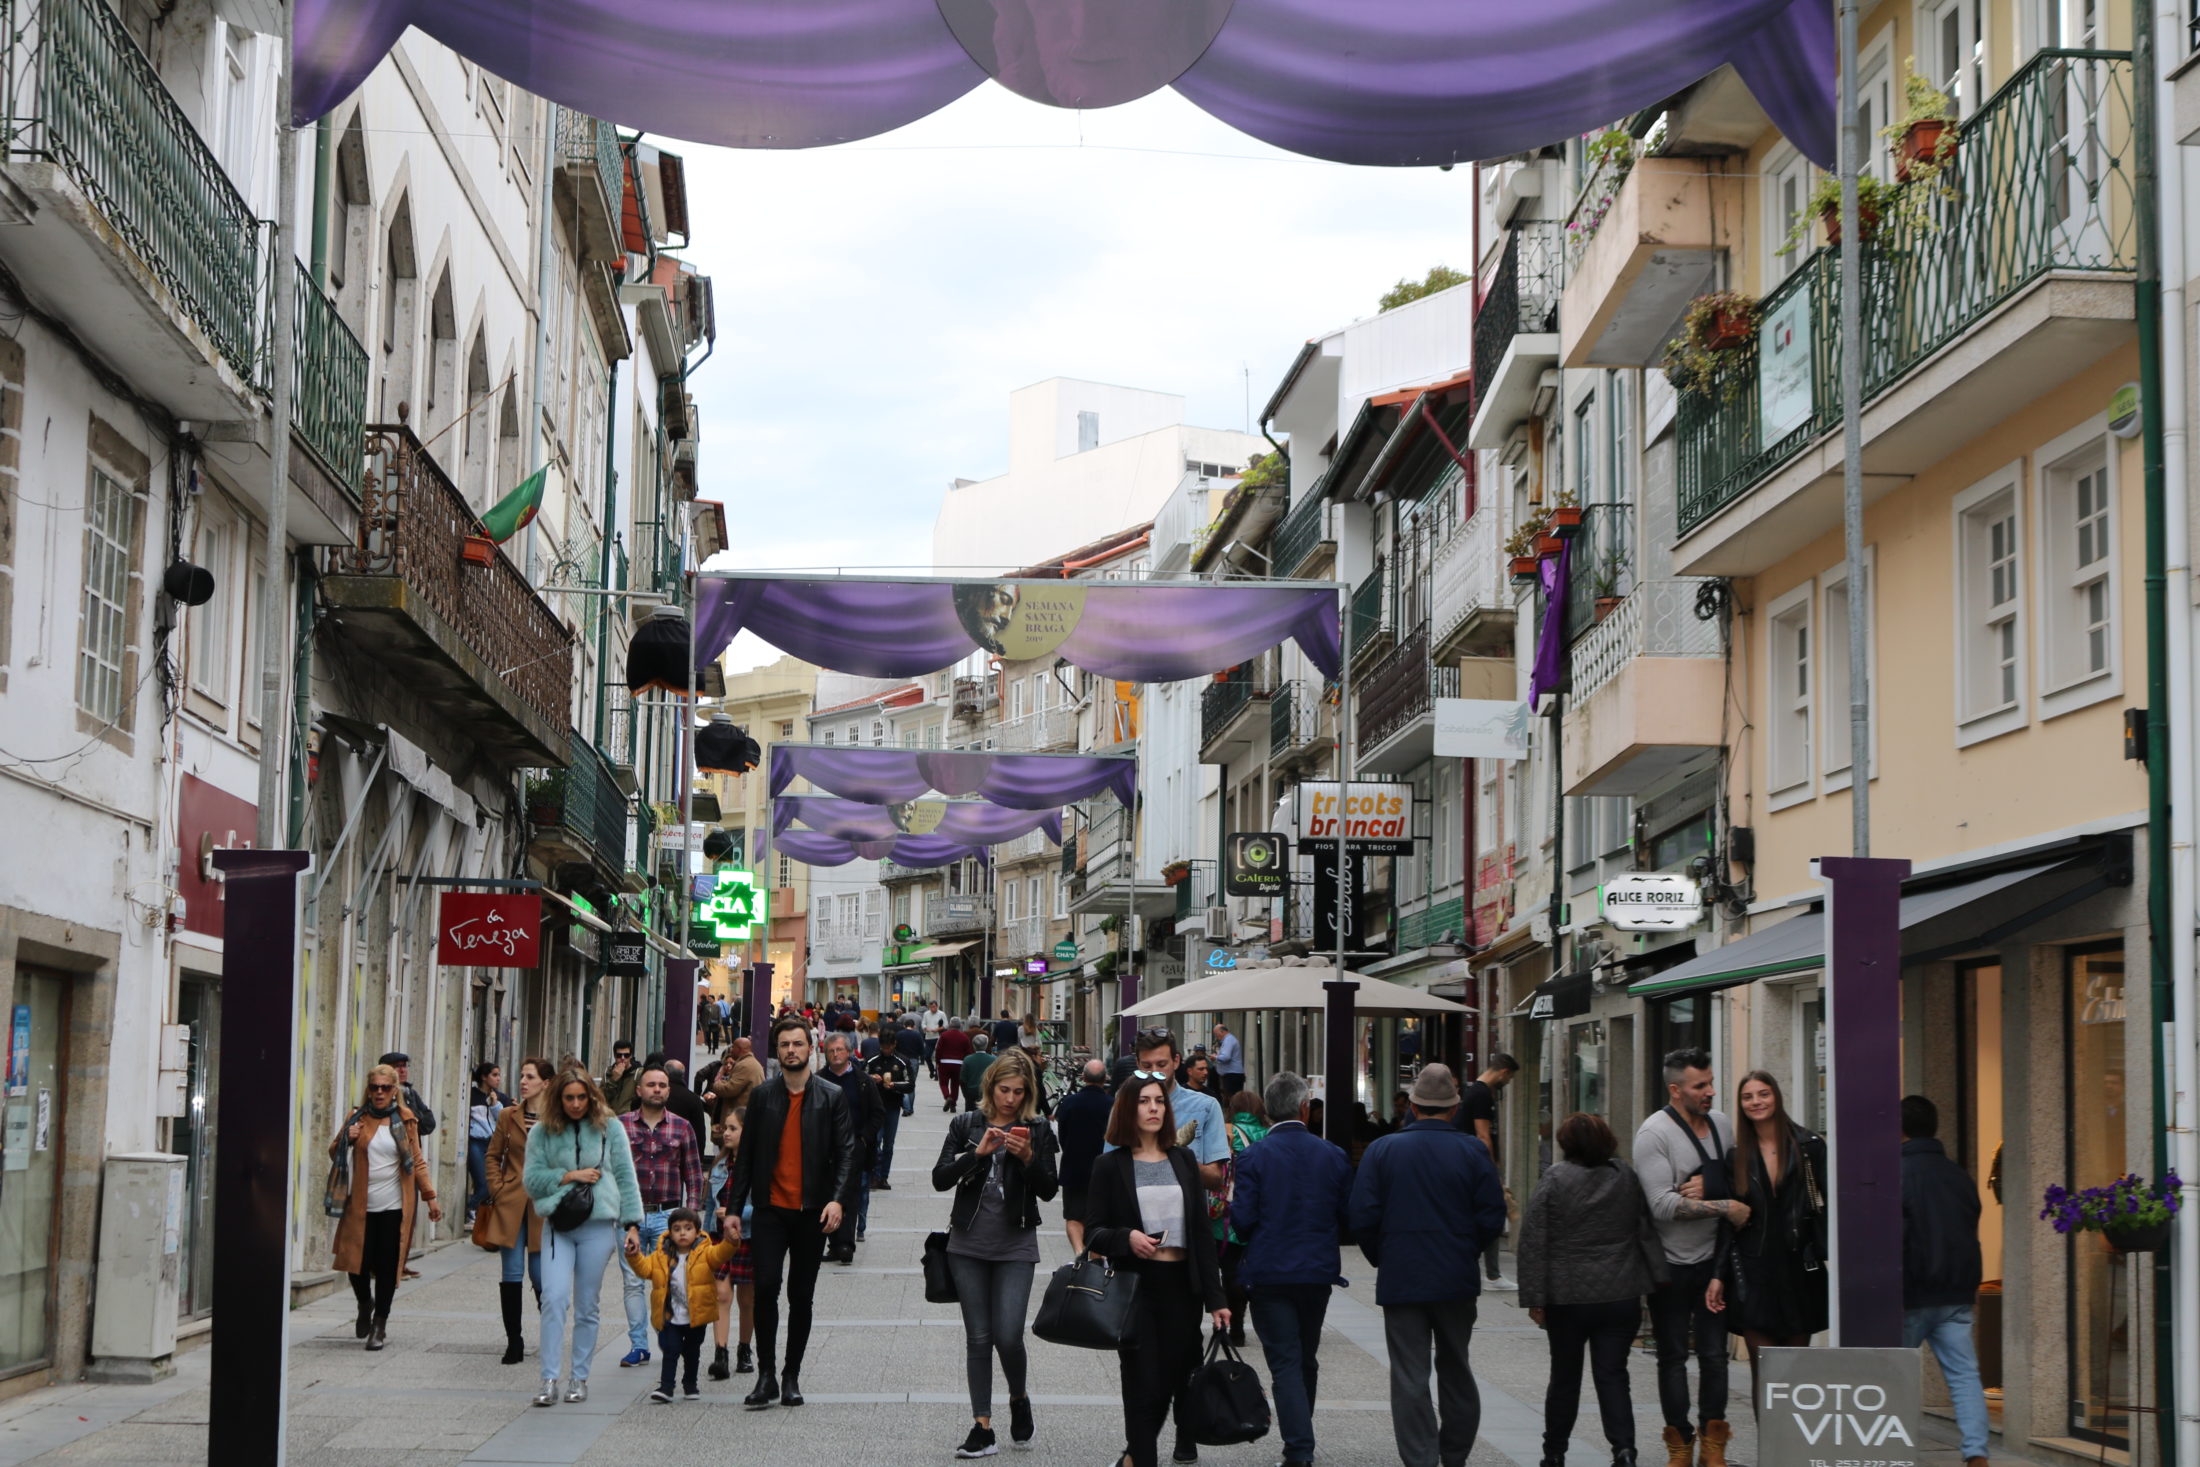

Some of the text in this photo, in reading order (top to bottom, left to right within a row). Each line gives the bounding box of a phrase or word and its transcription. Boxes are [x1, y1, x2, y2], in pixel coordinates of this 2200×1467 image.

[1025, 601, 1074, 611] SEMANA
[1025, 612, 1063, 622] SANTA
[1025, 623, 1065, 633] BRAGA
[1259, 883, 1281, 893] Digital
[1607, 892, 1684, 906] ALICE RORIZ
[1766, 1382, 1886, 1411] FOTO
[1792, 1413, 1915, 1447] VIVA
